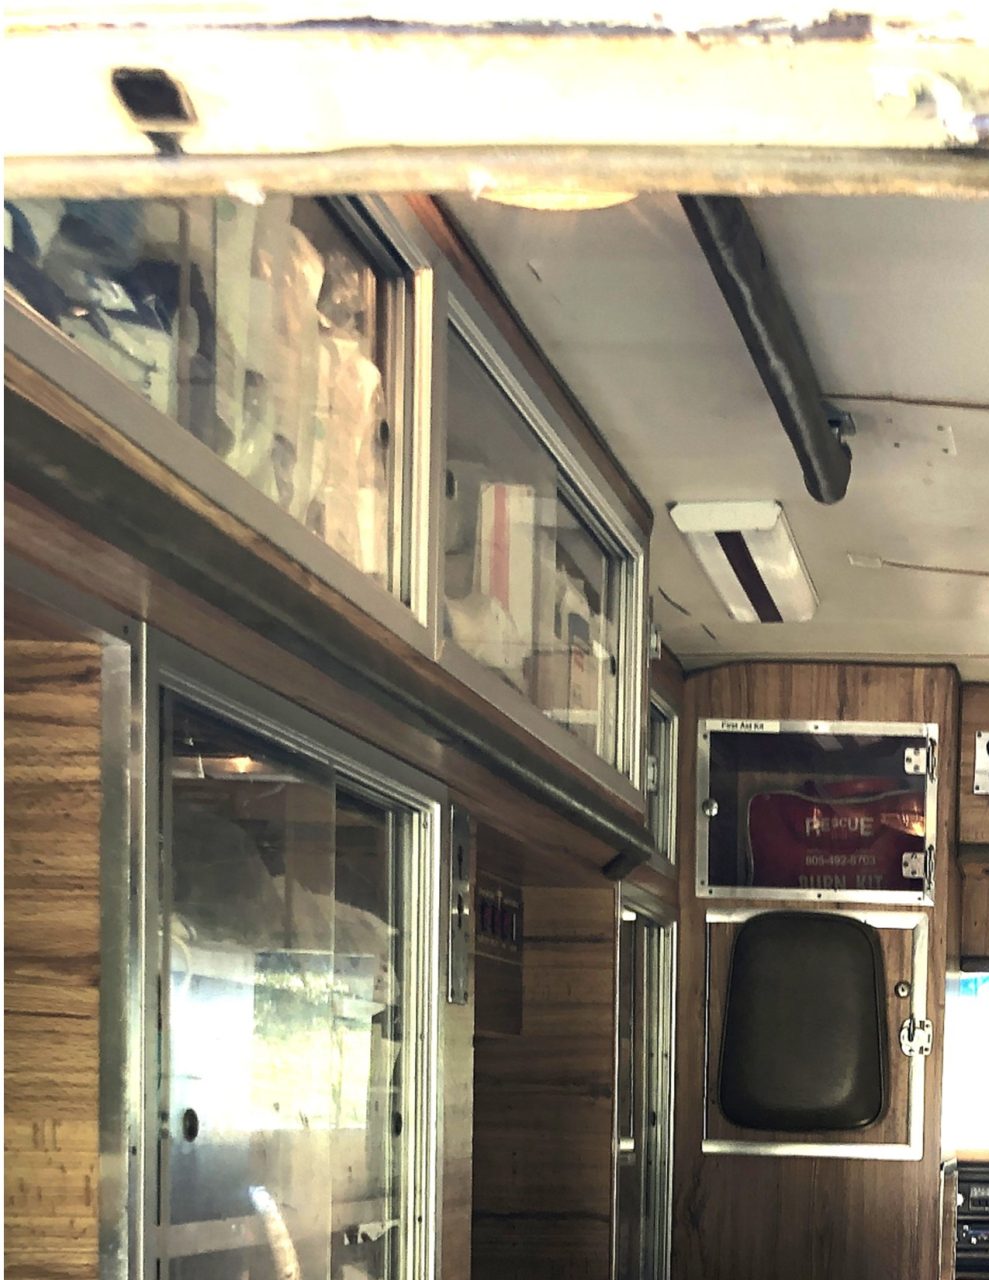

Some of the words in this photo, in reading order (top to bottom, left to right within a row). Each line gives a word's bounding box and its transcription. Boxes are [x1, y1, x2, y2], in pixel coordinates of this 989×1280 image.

[721, 721, 738, 729] First
[740, 721, 752, 729] Aid
[754, 722, 764, 730] Kit
